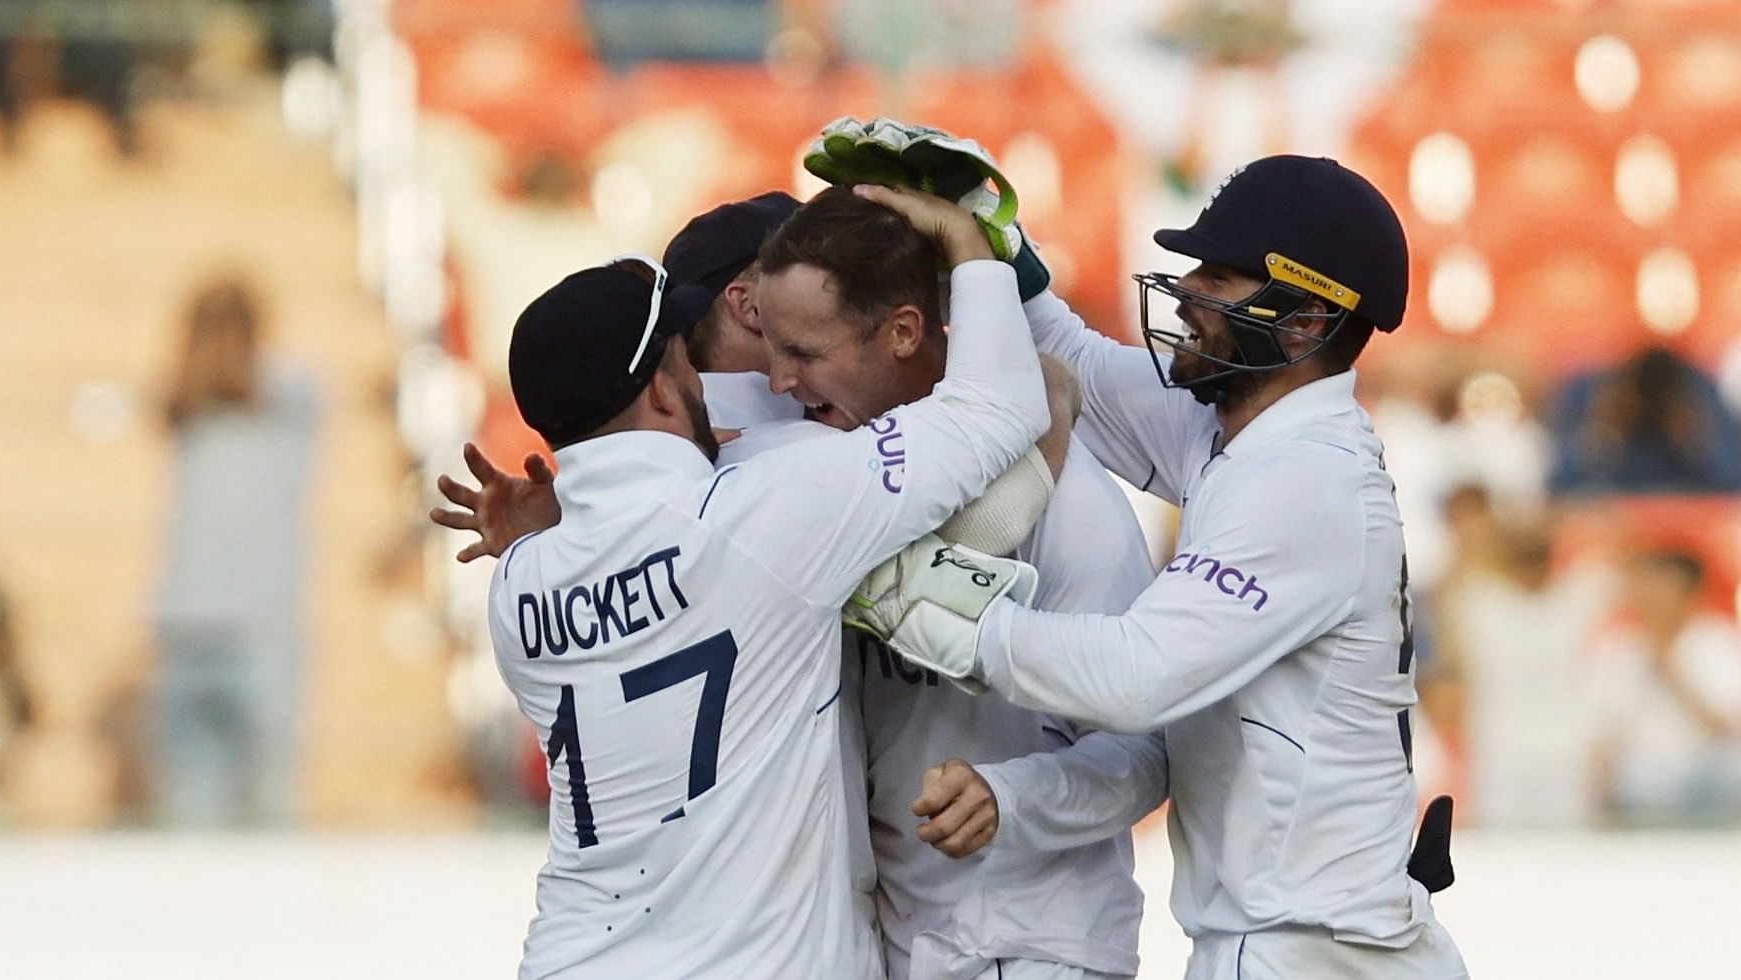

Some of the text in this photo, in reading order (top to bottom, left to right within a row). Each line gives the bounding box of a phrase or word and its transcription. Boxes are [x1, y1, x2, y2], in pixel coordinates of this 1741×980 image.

[1282, 263, 1332, 291] MASURI
[868, 412, 906, 494] cinc
[518, 545, 689, 659] DUCKETT
[1166, 546, 1268, 612] cnch
[547, 628, 738, 849] 17
